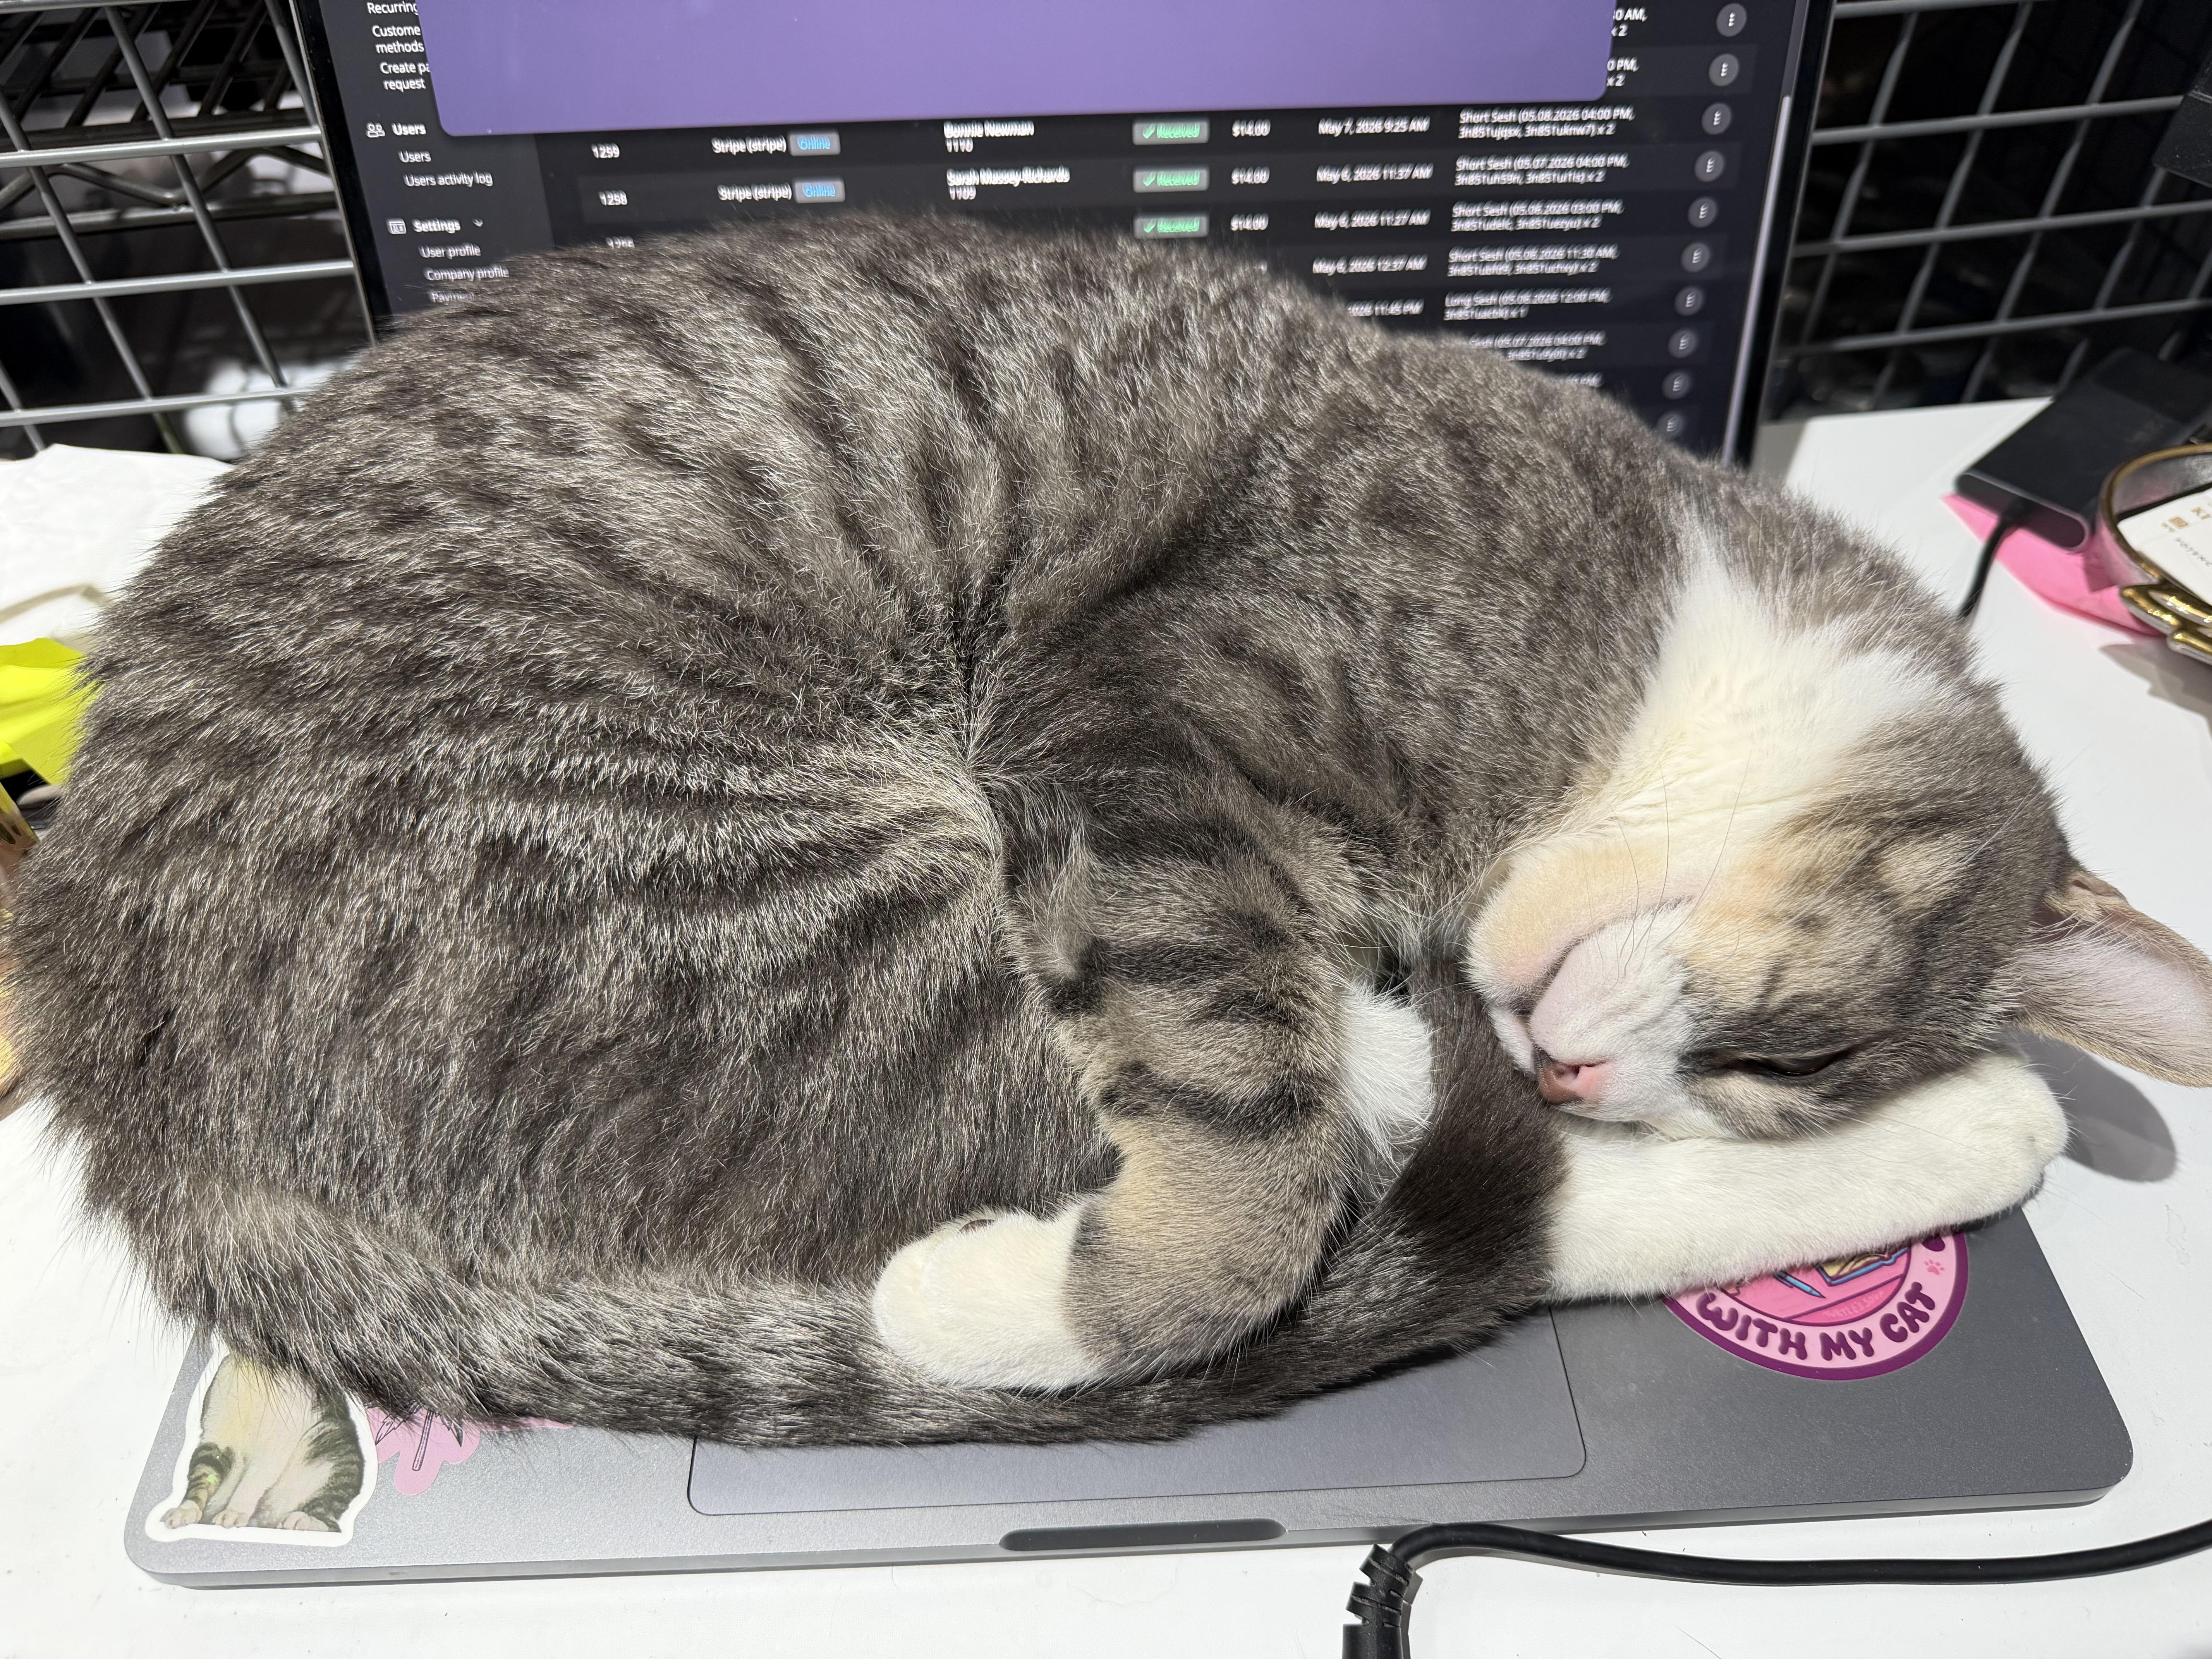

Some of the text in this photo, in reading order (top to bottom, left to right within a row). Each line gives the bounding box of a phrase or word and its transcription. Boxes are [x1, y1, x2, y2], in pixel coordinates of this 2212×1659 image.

[1624, 7, 1648, 22] AM,
[1618, 23, 1628, 36] 2
[375, 40, 424, 53] methods
[380, 61, 416, 74] Create
[1616, 57, 1639, 72] PM,
[383, 78, 426, 93] request
[1615, 72, 1626, 86] 2
[1460, 107, 1491, 124] Short
[1491, 107, 1518, 123] Sesh
[392, 124, 426, 136] Users
[984, 119, 1034, 137] Newman
[1156, 123, 1200, 139] Received
[1232, 119, 1271, 137] $14.00
[1319, 118, 1343, 137] May
[1355, 117, 1384, 134] 2026
[1408, 115, 1430, 132] AM
[1606, 120, 1617, 135] 2
[711, 136, 787, 155] Stripe (stripe)
[797, 134, 830, 151] Online
[398, 151, 431, 163] Users
[1487, 155, 1514, 171] Sesh
[404, 171, 493, 187] Users activity log
[1157, 171, 1200, 186] Received
[1231, 166, 1270, 184] $14.00
[1317, 165, 1341, 184] May
[1353, 163, 1383, 181] 2026
[1412, 162, 1433, 179] AM
[1594, 168, 1606, 182] 2
[717, 182, 792, 203] Stripe (stripe)
[802, 182, 835, 198] Online
[411, 218, 461, 234] Settings
[1157, 218, 1200, 233] Received
[1314, 211, 1339, 231] May
[1351, 210, 1381, 227] 2026
[1408, 208, 1431, 225] AM
[419, 242, 481, 259] User profile
[423, 264, 509, 282] Company profile
[1313, 257, 1336, 276] May
[1348, 256, 1377, 273] 2026
[1405, 254, 1428, 271] AM
[1403, 299, 1424, 314] PM
[1695, 1281, 1936, 1362] WITH MY CAT
